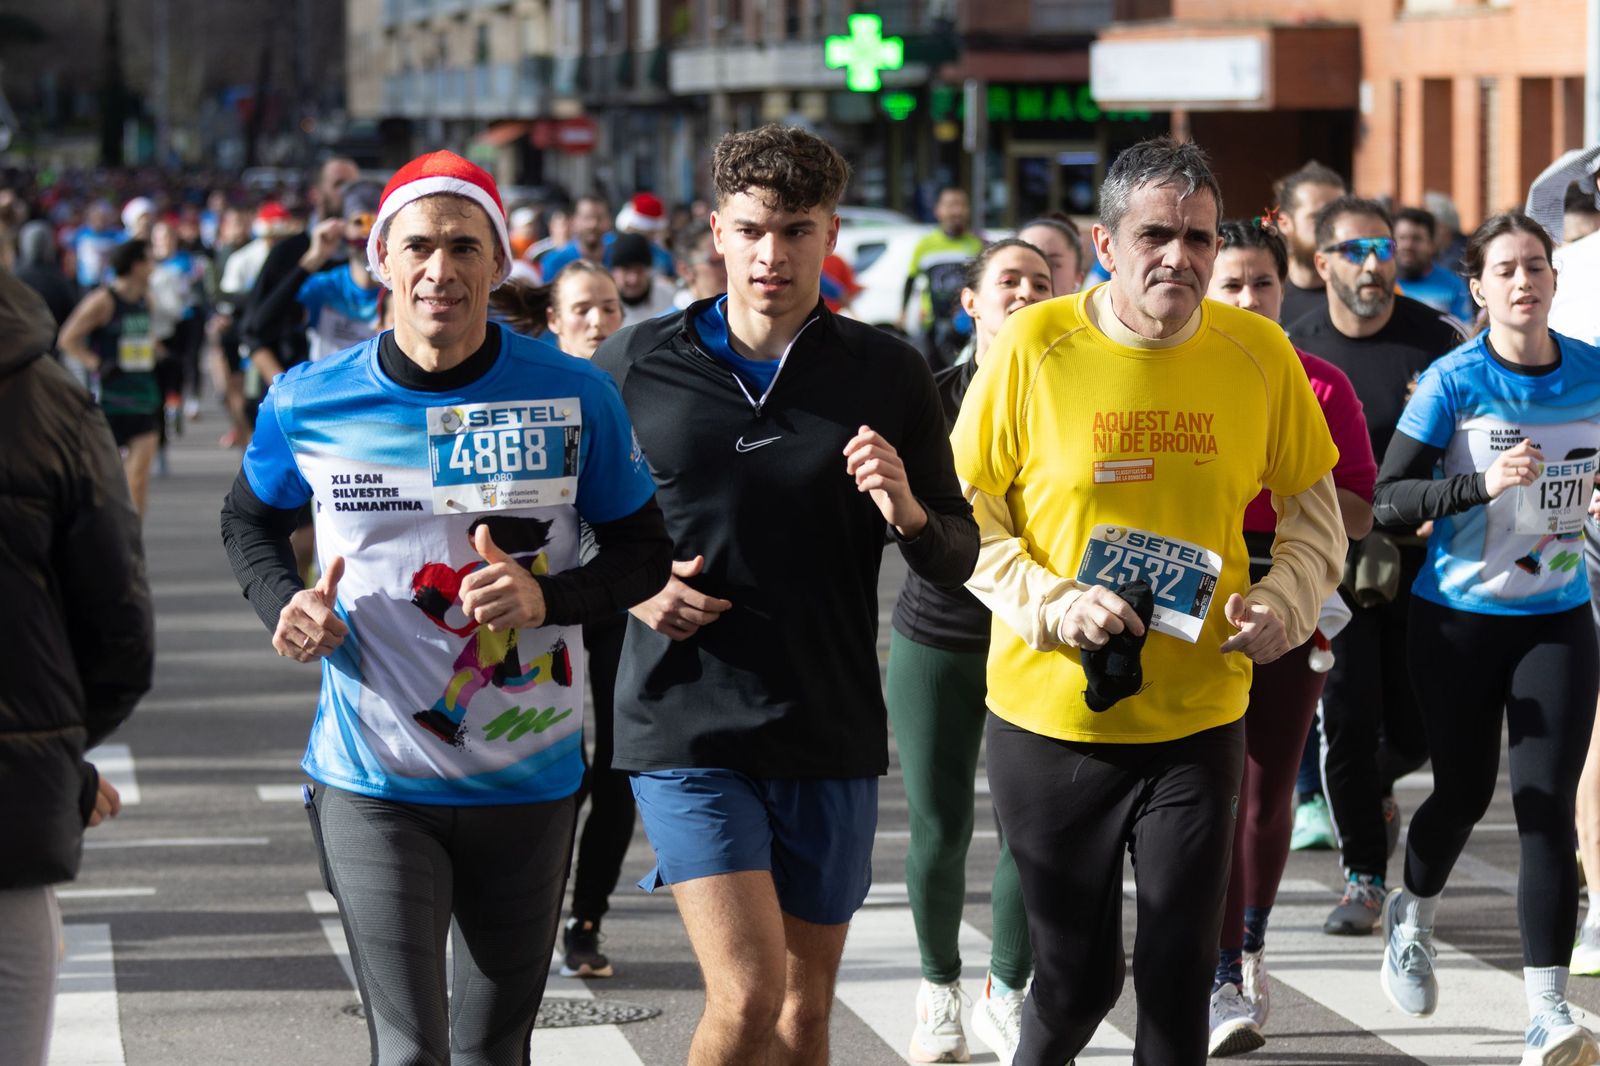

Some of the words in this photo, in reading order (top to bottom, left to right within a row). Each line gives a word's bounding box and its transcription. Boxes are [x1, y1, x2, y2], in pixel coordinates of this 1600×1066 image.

[468, 406, 566, 427] SETEL
[1092, 410, 1170, 433] AQUEST
[1173, 411, 1214, 434] ANY
[449, 428, 547, 476] 4868
[1093, 432, 1113, 453] NI
[1119, 432, 1145, 453] DE
[1149, 432, 1218, 454] BROMA
[487, 472, 513, 483] LOBO
[1547, 460, 1596, 477] SETEL
[331, 475, 351, 485] XLI
[354, 474, 383, 484] SAN
[332, 487, 399, 499] SILVESTRE
[500, 490, 539, 498] Ayuntamiento
[1540, 478, 1583, 509] 1371
[335, 501, 424, 512] SALMANTINA
[1126, 532, 1209, 568] SETEL
[1096, 545, 1185, 602] 2532
